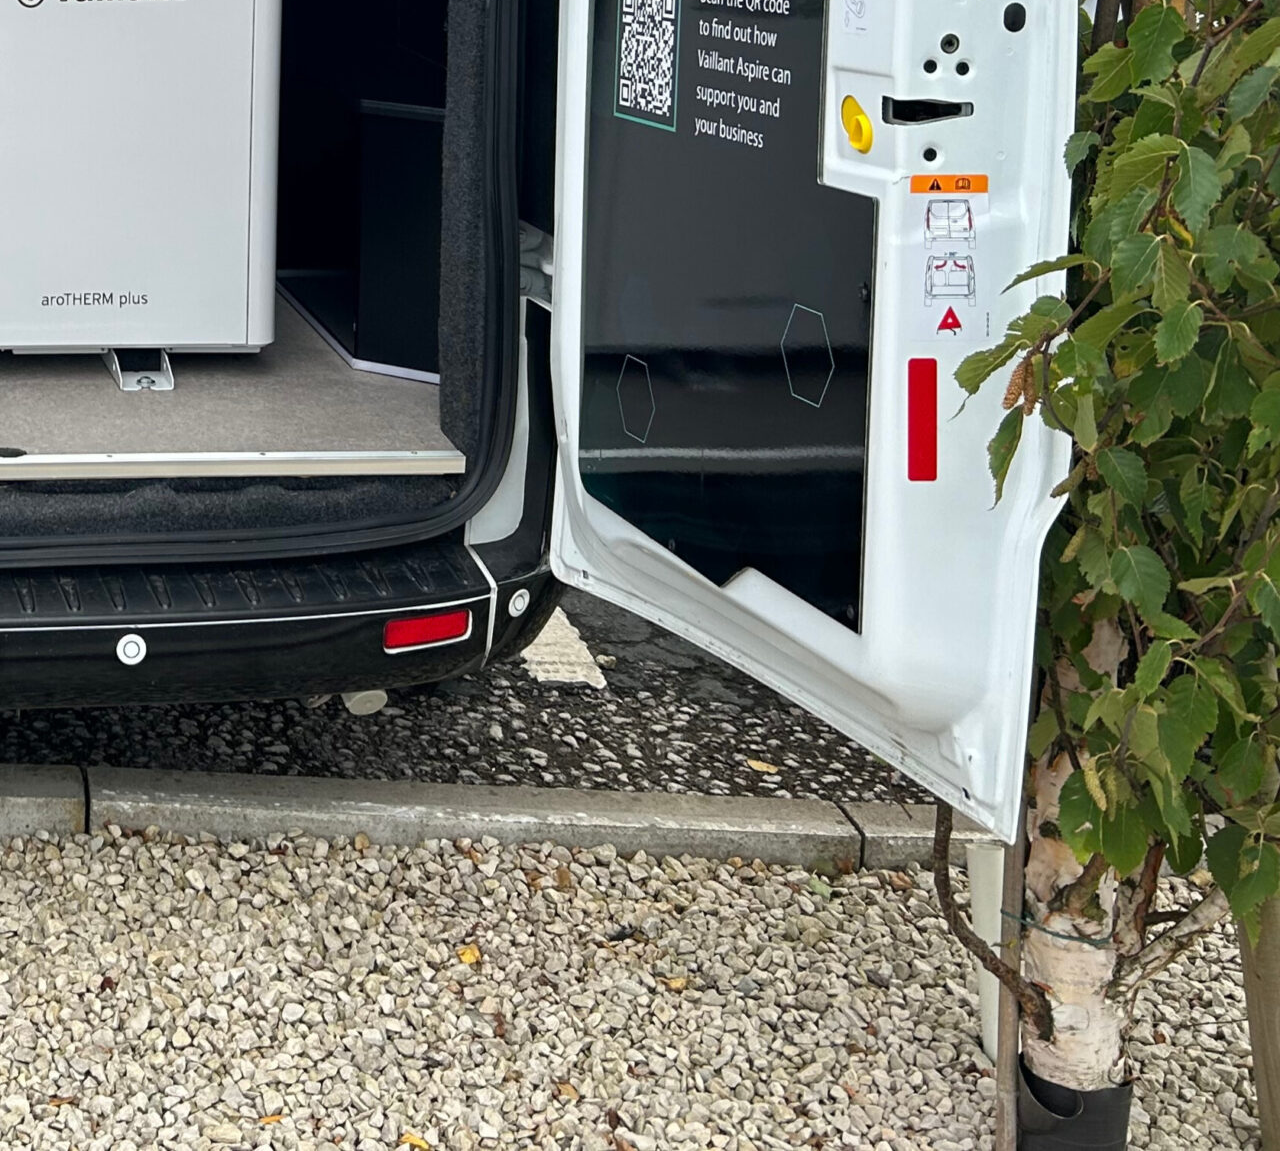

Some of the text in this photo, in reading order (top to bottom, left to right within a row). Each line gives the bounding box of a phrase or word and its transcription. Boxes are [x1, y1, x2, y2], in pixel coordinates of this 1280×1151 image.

[699, 18, 778, 47] to find out how
[698, 49, 791, 85] Vaillant Aspire can
[696, 85, 780, 118] support you and
[695, 117, 764, 148] your business
[41, 291, 149, 308] aroTHERM plus
